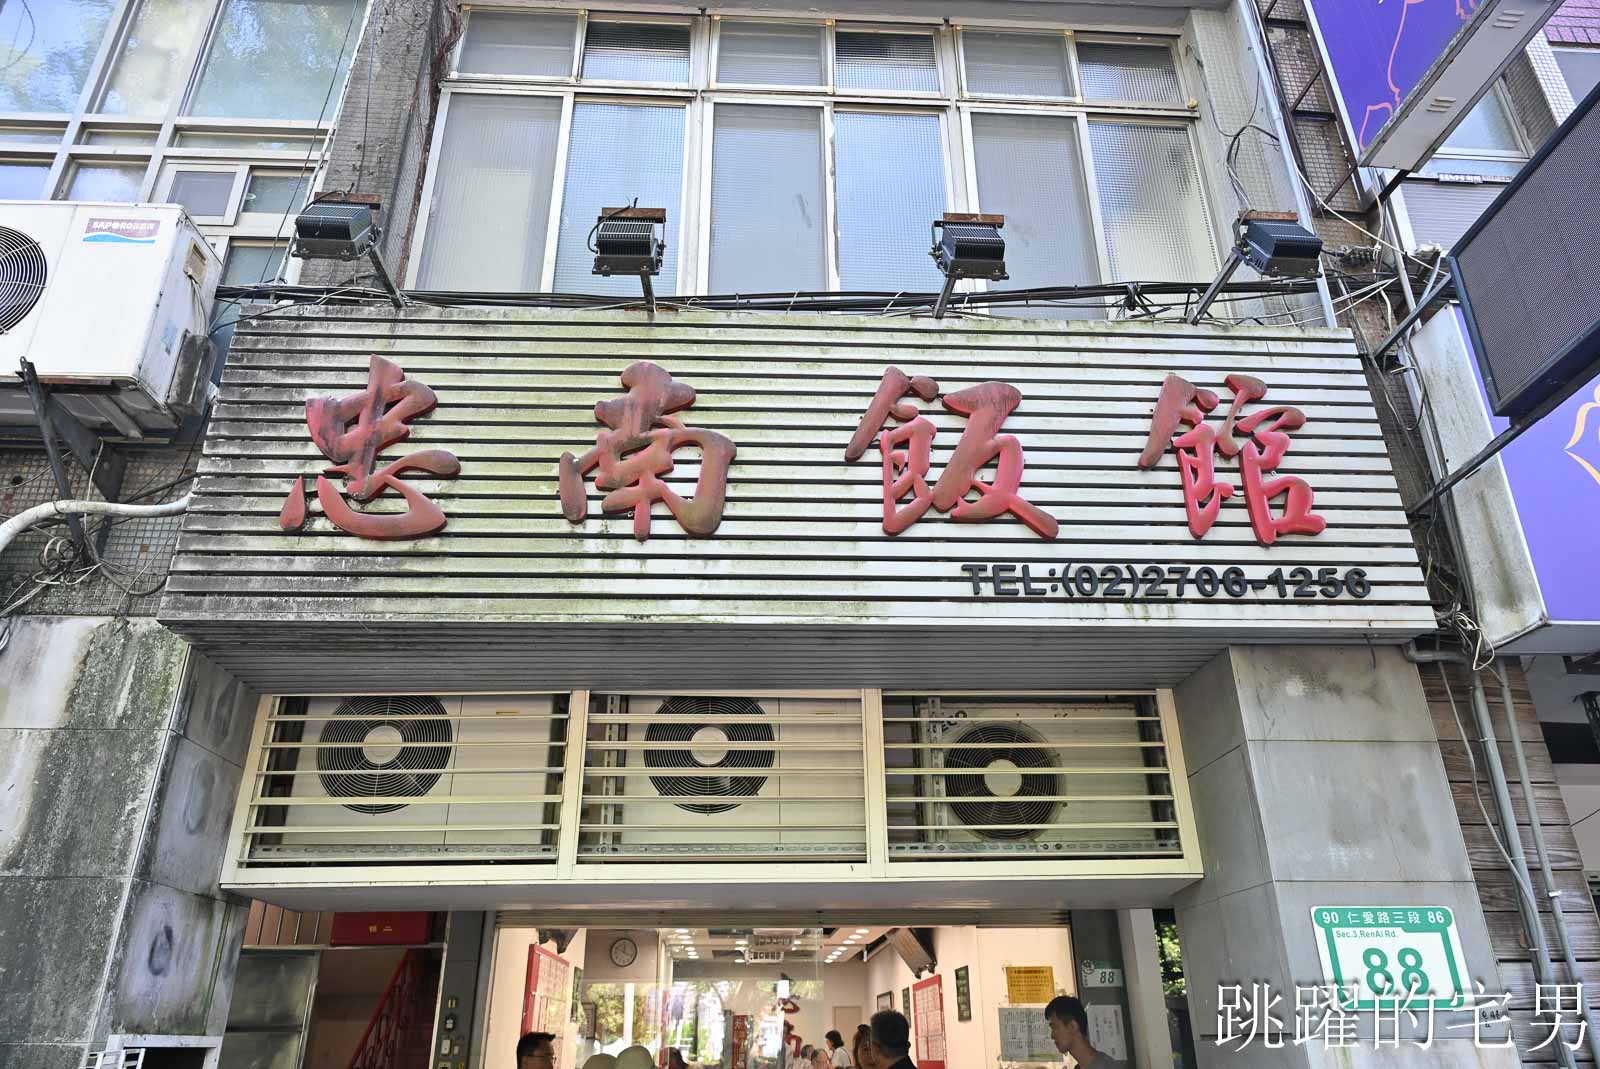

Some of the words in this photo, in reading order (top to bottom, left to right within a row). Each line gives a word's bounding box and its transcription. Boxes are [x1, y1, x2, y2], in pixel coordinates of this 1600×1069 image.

[961, 562, 1371, 599] TEL:(02)2706-1256
[1322, 911, 1339, 924] 90
[1347, 911, 1421, 924] 仁愛路三段
[1427, 911, 1445, 924] 86
[1099, 971, 1115, 984] 88
[1362, 947, 1430, 995] 88
